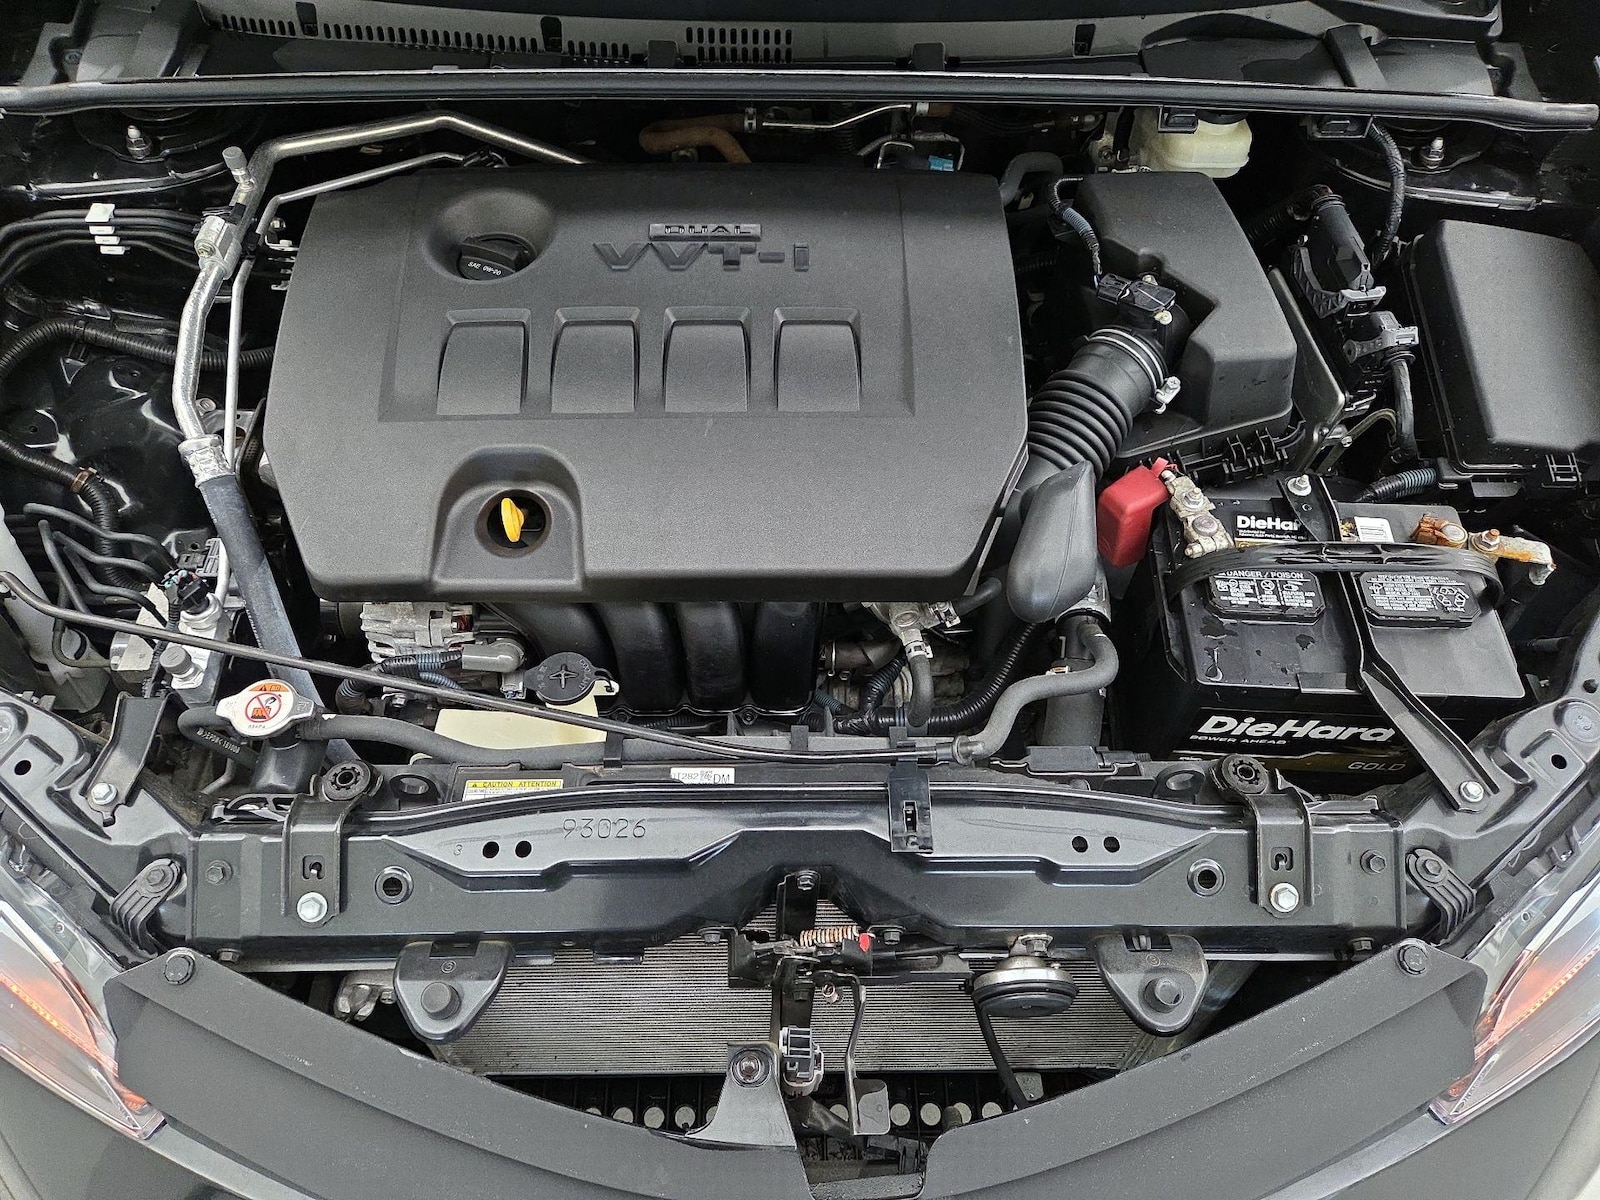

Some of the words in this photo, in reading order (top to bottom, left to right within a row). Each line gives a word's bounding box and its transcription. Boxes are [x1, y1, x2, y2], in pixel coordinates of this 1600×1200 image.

[664, 224, 751, 234] DUAL
[467, 261, 481, 270] SAE
[1226, 570, 1263, 578] DANGER
[1270, 571, 1304, 579] POISON
[1189, 735, 1237, 743] POWER
[1347, 761, 1406, 771] GOLD
[562, 818, 647, 839] 93026
